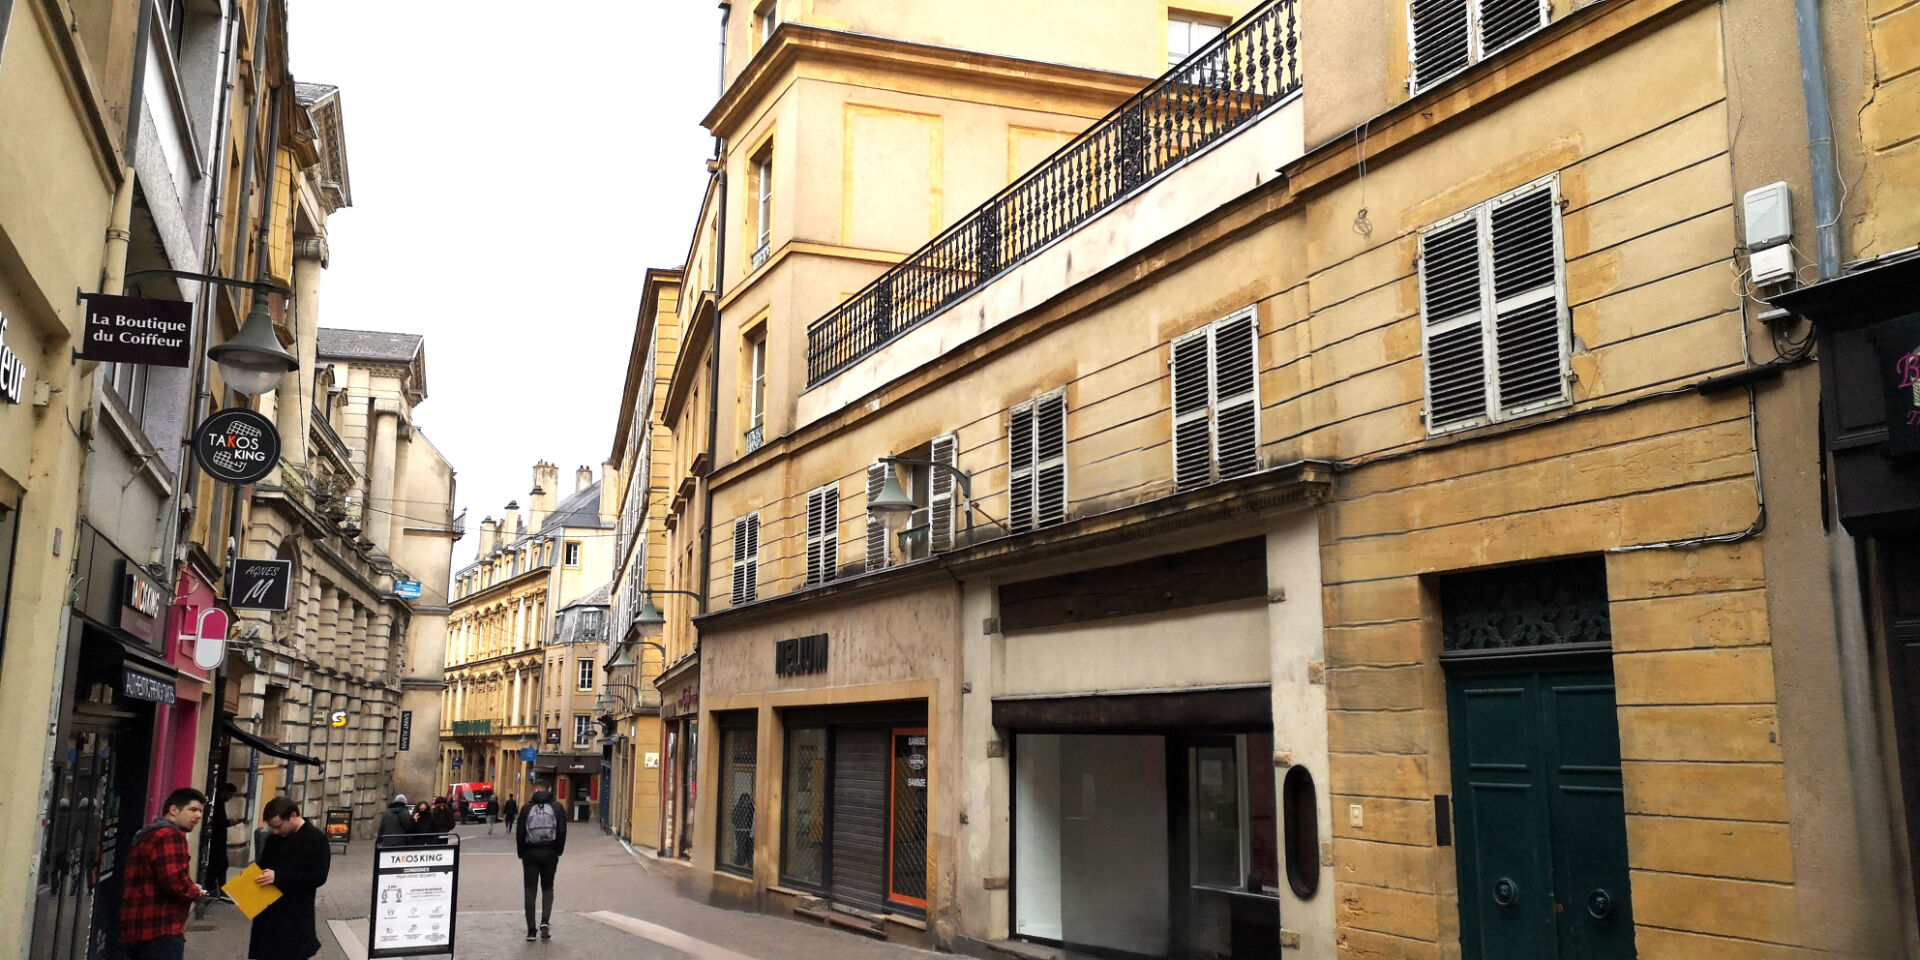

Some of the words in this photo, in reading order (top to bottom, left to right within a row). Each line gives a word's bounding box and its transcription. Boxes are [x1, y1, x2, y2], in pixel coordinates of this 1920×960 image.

[92, 312, 110, 326] La
[115, 314, 187, 334] Boutique
[93, 329, 114, 343] du
[119, 332, 183, 348] Coiffeur
[208, 432, 259, 450] TAKOS
[234, 449, 266, 462] KING
[244, 565, 280, 578] AGNES
[241, 578, 275, 604] M
[391, 855, 418, 864] TAKOS
[419, 853, 443, 862] KING
